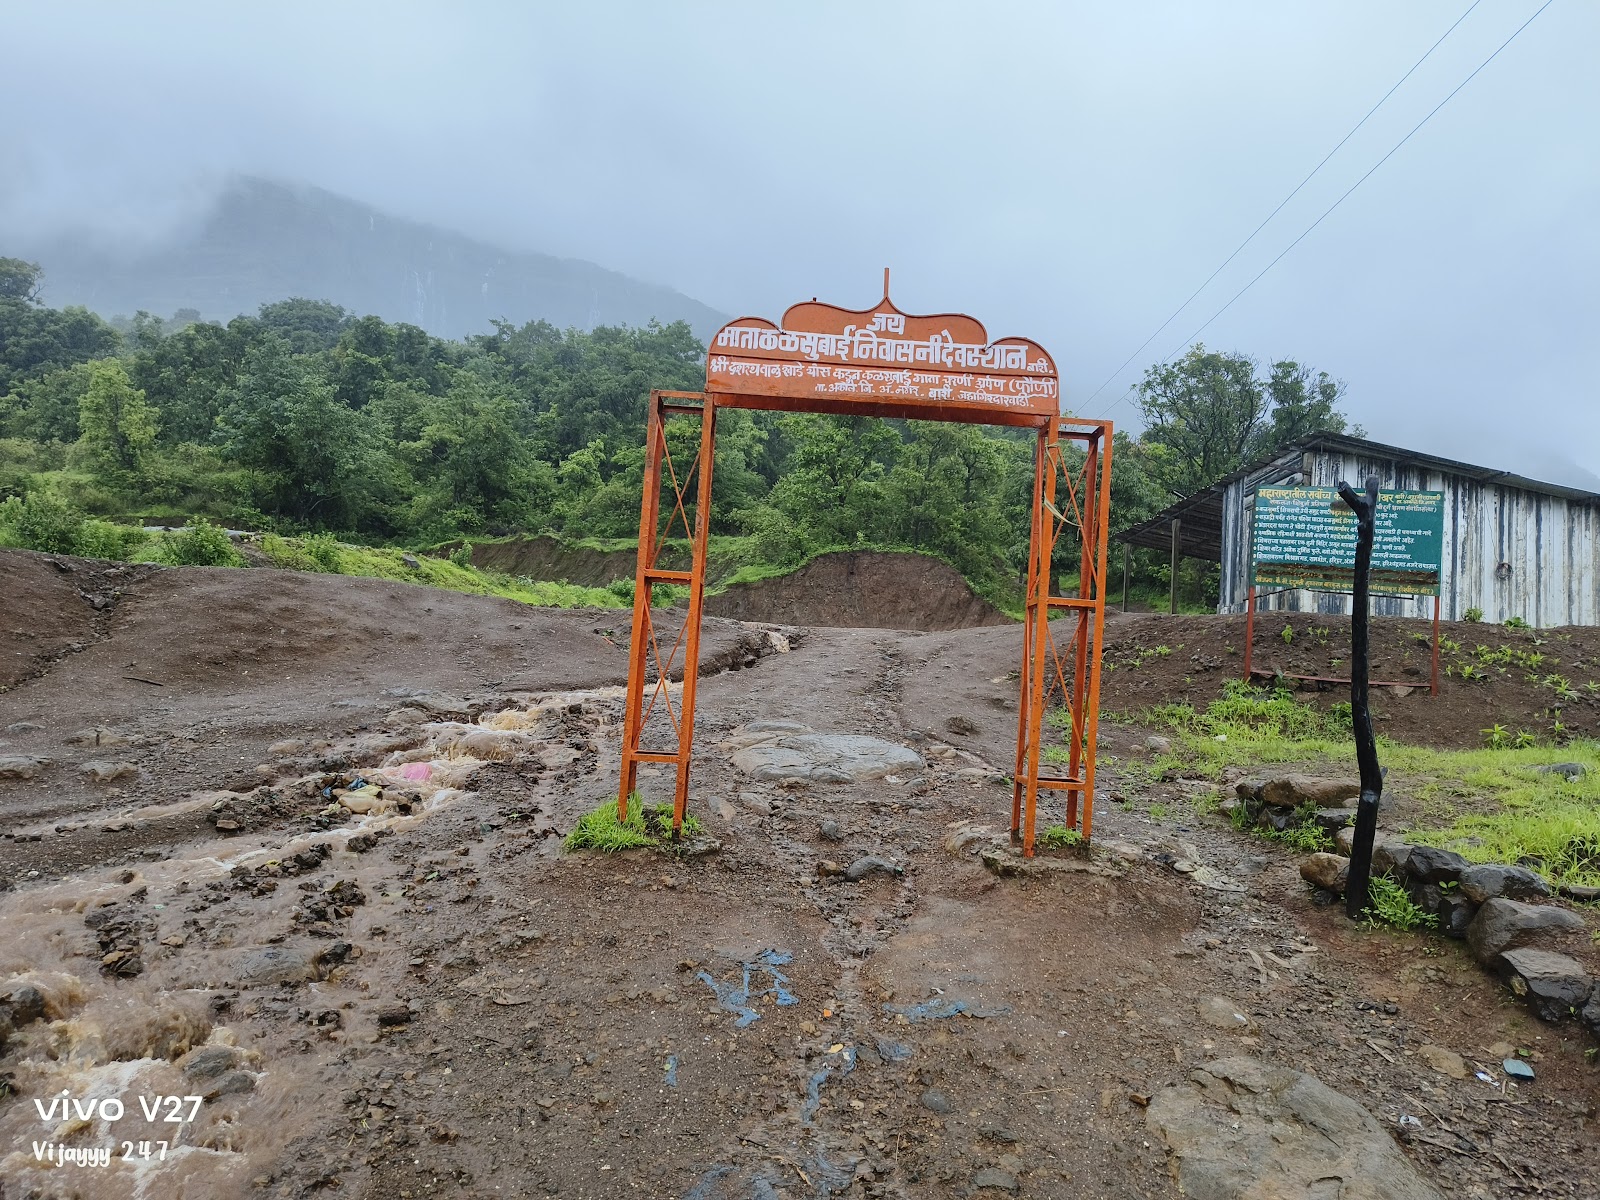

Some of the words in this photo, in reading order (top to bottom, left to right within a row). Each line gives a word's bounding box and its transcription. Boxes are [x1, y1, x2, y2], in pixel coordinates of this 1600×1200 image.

[866, 313, 905, 335] जय
[710, 355, 729, 372] श्री
[942, 373, 974, 388] चरणी
[975, 375, 1006, 392] अर्पण
[1258, 487, 1307, 501] महाराष्ट्रातील
